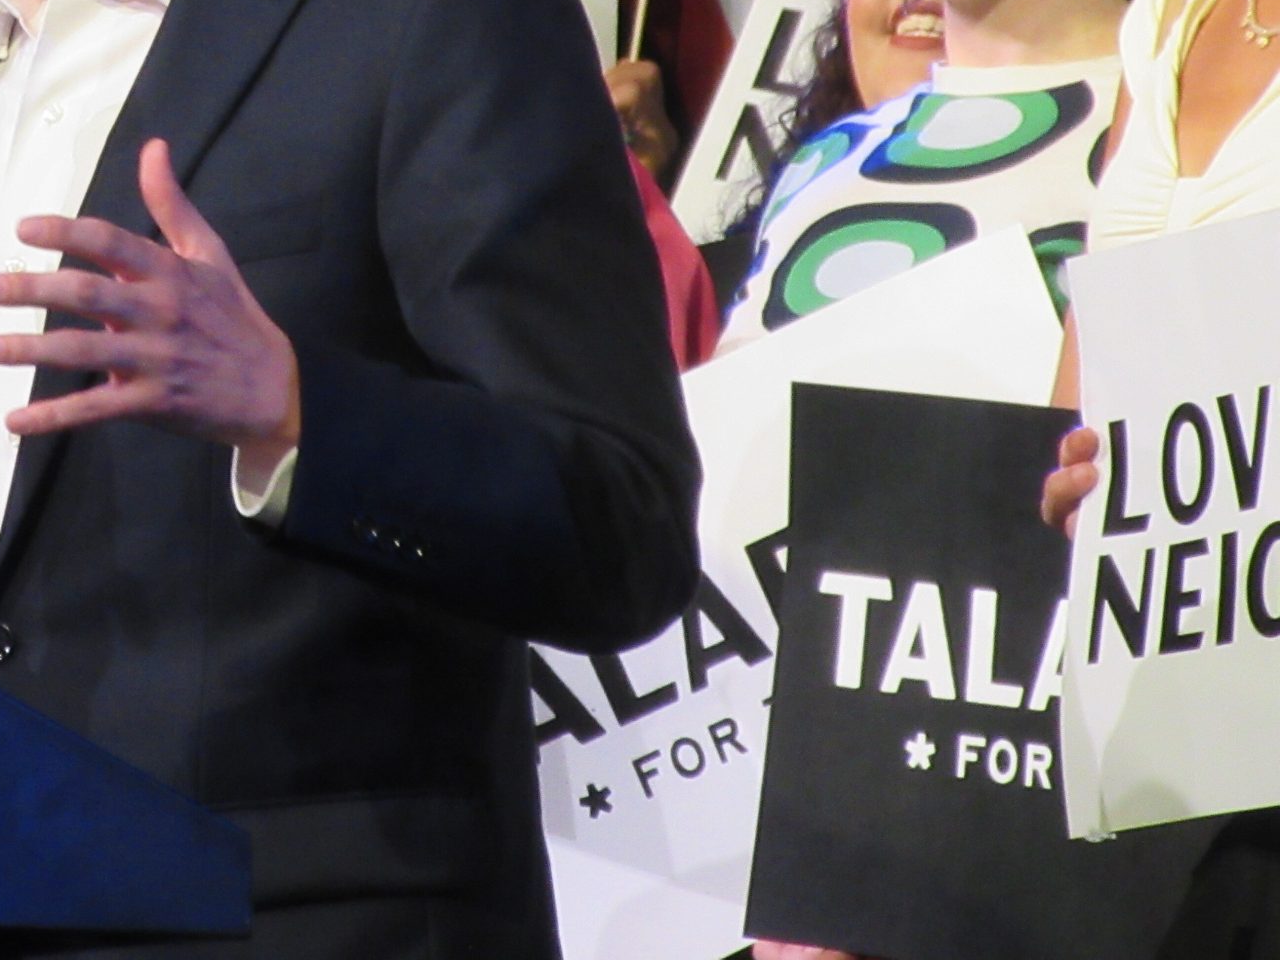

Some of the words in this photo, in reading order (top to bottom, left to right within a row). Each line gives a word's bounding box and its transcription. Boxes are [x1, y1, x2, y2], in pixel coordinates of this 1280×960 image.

[1102, 384, 1271, 537] LOV
[632, 717, 748, 798] FOR
[955, 733, 1052, 790] FOR
